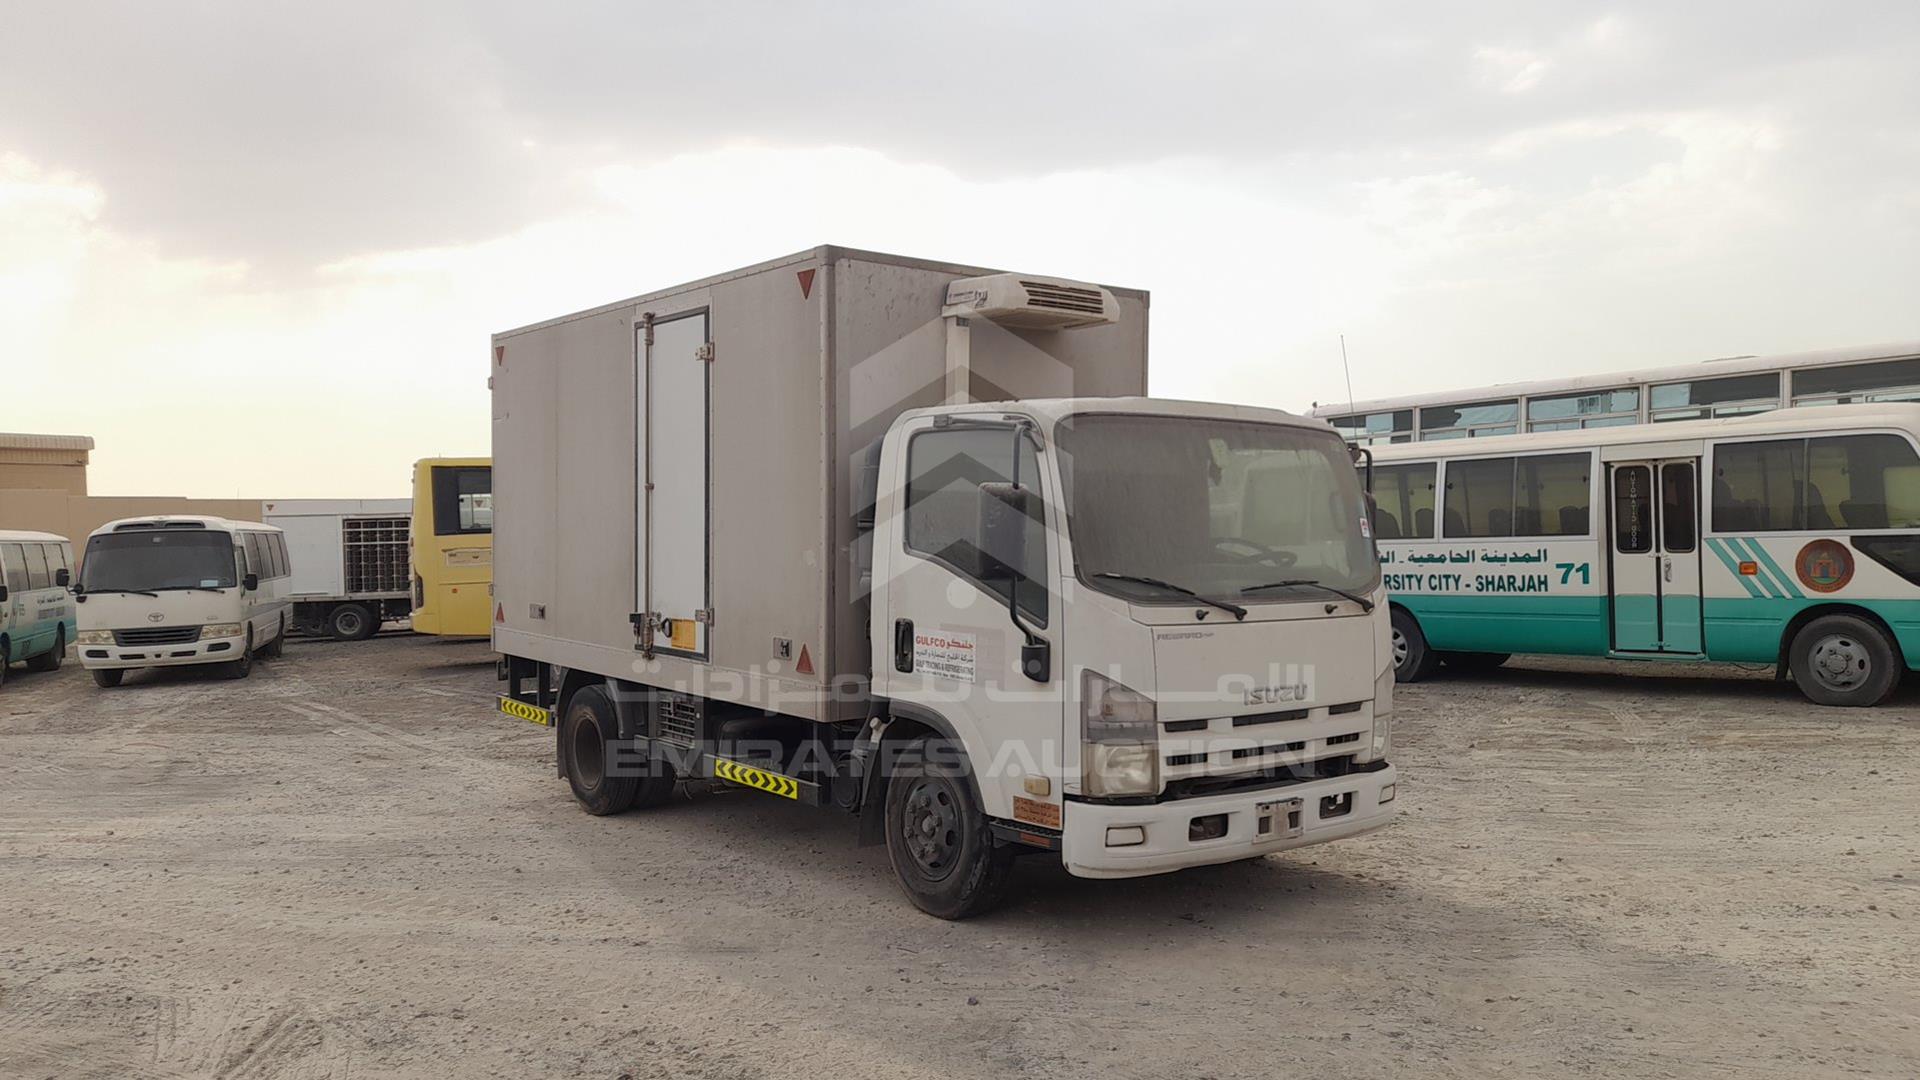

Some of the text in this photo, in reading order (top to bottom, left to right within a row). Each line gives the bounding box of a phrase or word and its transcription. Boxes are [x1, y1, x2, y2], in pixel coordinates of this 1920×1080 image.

[1481, 548, 1547, 567] المدينة
[1383, 574, 1423, 590] RSITY
[1428, 574, 1461, 591] CITY
[1475, 574, 1548, 592] SHARJAH
[1555, 563, 1590, 585] 71
[916, 635, 945, 648] GULFCO
[1243, 684, 1307, 706] ISUZU
